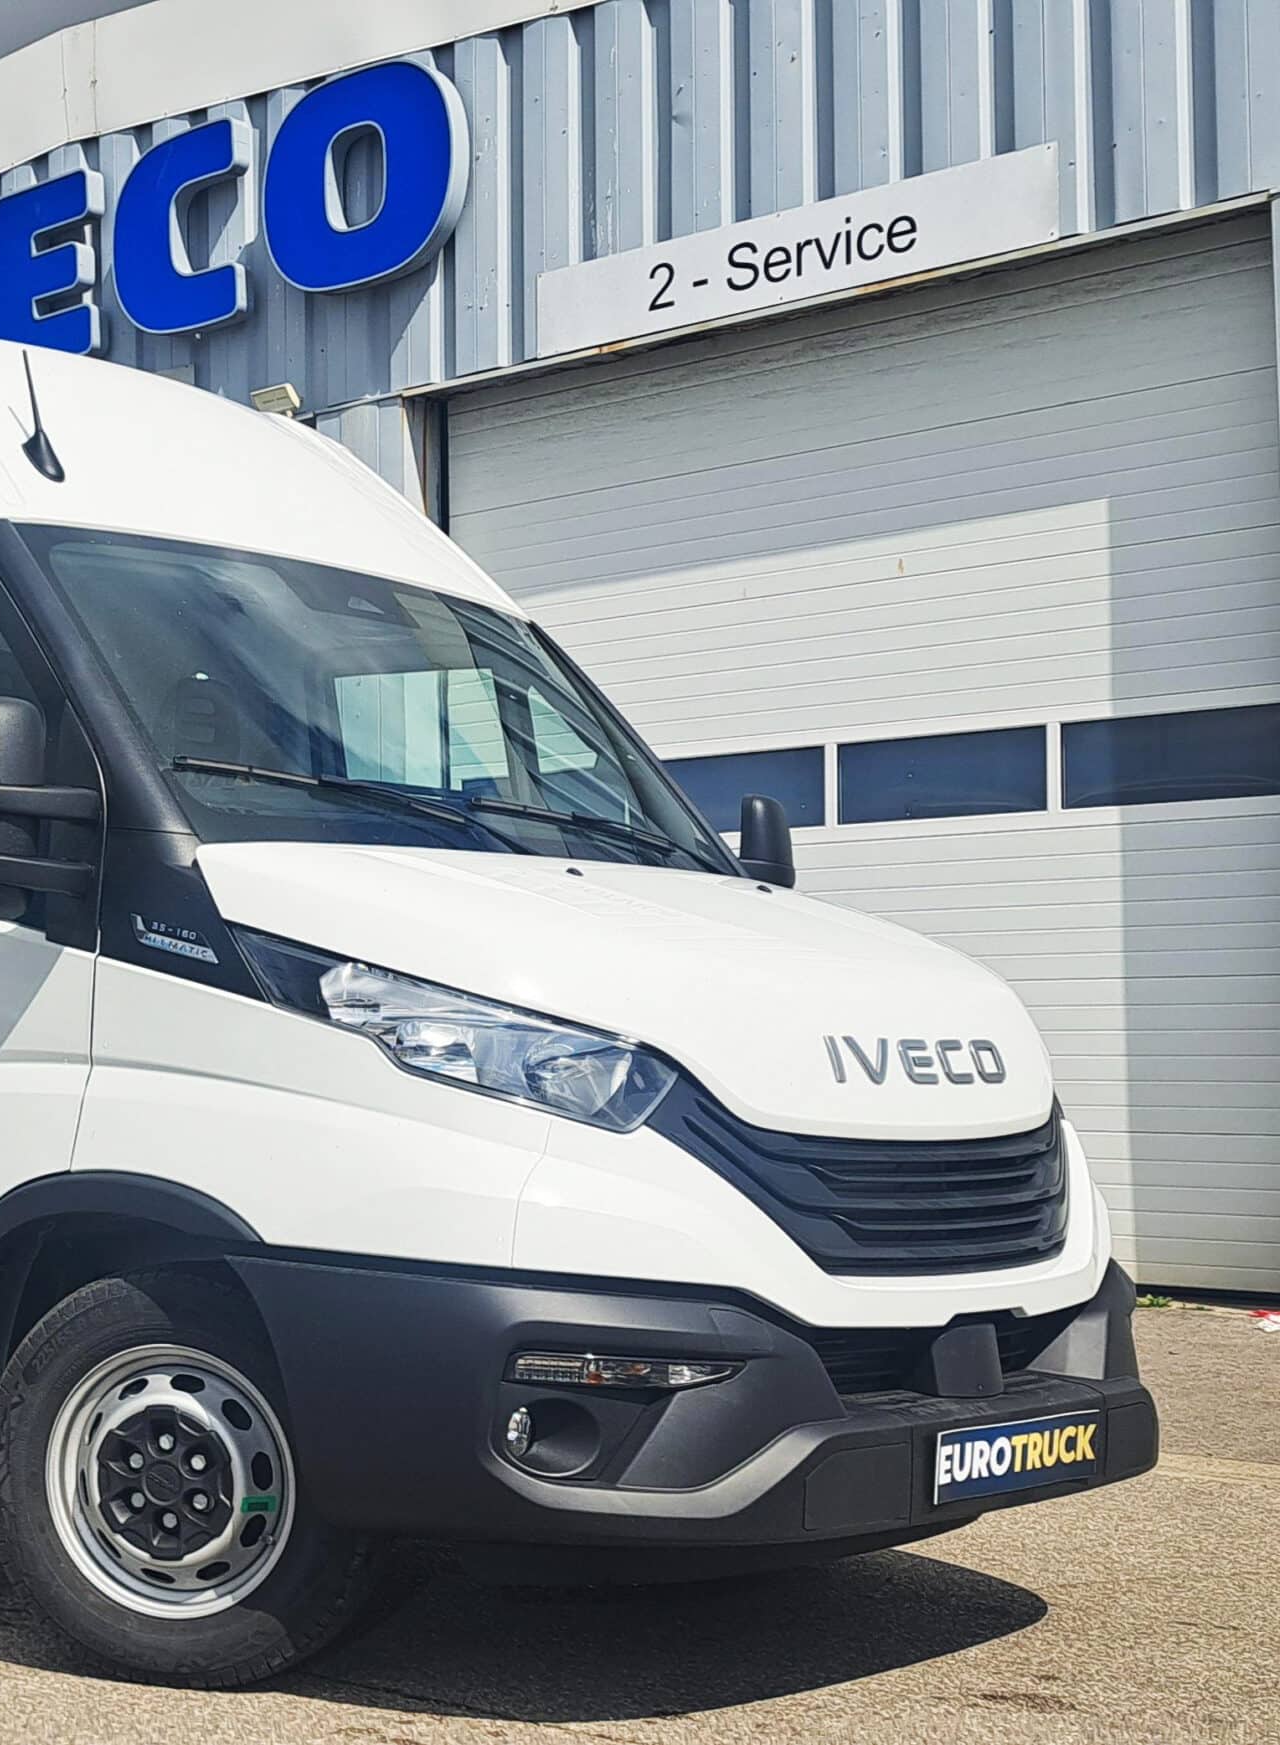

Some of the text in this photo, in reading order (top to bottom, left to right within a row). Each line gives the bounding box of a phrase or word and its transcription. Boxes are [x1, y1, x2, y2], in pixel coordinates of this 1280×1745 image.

[647, 261, 676, 312] 2
[725, 213, 919, 292] Service
[822, 1034, 1007, 1086] IVECO
[939, 1423, 1098, 1486] EUROTRUCK
